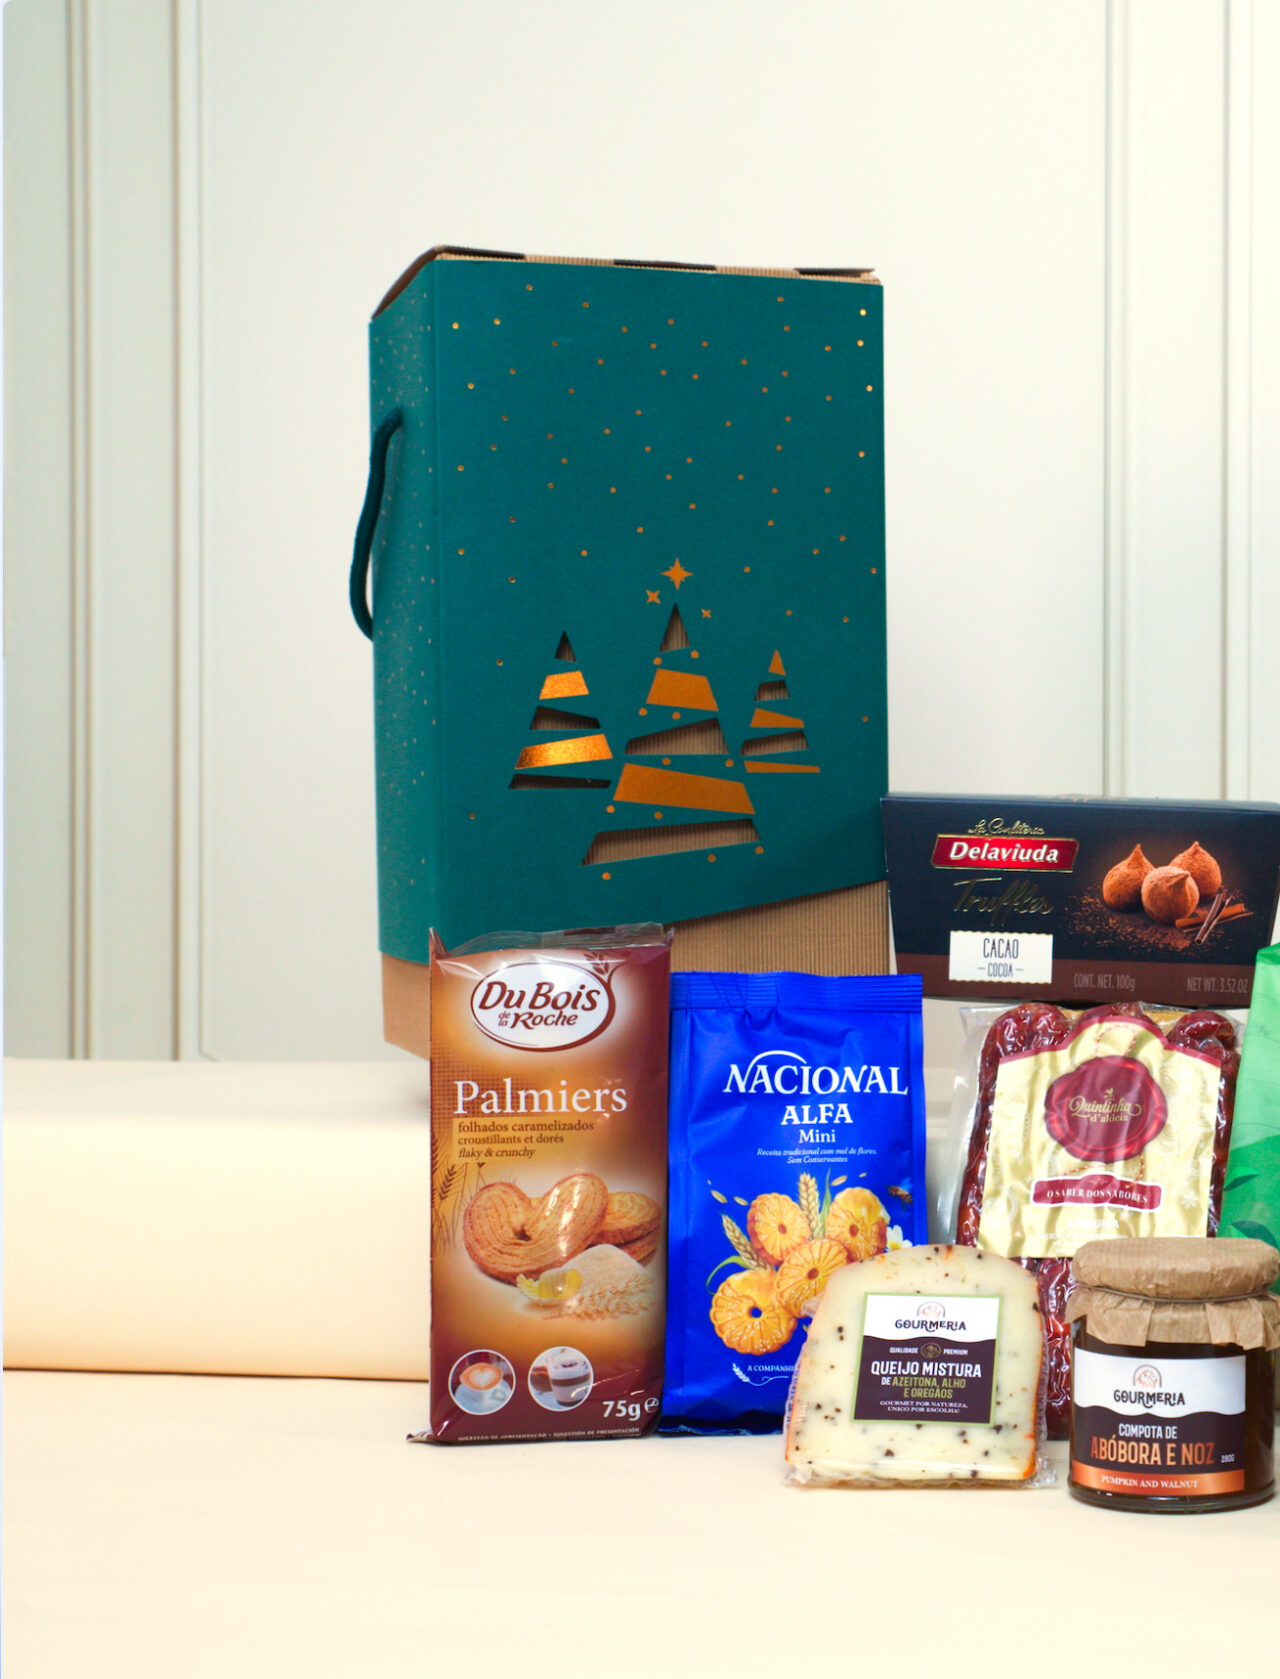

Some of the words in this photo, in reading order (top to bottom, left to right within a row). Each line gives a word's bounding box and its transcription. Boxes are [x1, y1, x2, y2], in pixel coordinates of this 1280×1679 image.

[949, 842, 1059, 862] Delaviuda
[953, 877, 1054, 926] Truffles
[983, 938, 1019, 959] CACAO
[987, 962, 1013, 977] COCOA
[1073, 973, 1096, 987] CONT.
[1098, 974, 1114, 989] NET.
[1116, 974, 1136, 992] 100g
[1187, 977, 1202, 992] NET
[1220, 978, 1236, 993] 3.52
[478, 981, 526, 1010] Du
[528, 981, 600, 1011] Bois
[498, 1011, 510, 1019] de
[510, 1011, 578, 1029] Roche
[723, 1051, 909, 1095] NACIONAL
[453, 1077, 628, 1114] Palmiers
[780, 1103, 853, 1125] ALFA
[458, 1120, 509, 1133] folhados
[511, 1119, 594, 1132] caramelizados
[458, 1134, 522, 1145] croustillants
[524, 1135, 534, 1144] et
[536, 1134, 564, 1144] dorés
[798, 1129, 836, 1143] Mini
[458, 1147, 483, 1160] flaky
[484, 1148, 493, 1157] &
[495, 1147, 536, 1159] crunchy
[757, 1148, 782, 1156] Receita
[783, 1147, 819, 1156] tradicional
[835, 1147, 848, 1155] mel
[787, 1156, 802, 1164] Sem
[1047, 1190, 1053, 1198] O
[1055, 1188, 1084, 1197] SABER
[1086, 1189, 1105, 1198] DOS
[1106, 1189, 1148, 1203] SABORES
[895, 1319, 967, 1333] GOURMERIA
[871, 1361, 919, 1375] QUEIJO
[922, 1361, 981, 1378] MISTURA
[881, 1377, 891, 1385] DE
[892, 1377, 940, 1388] AZEITONA,
[942, 1378, 966, 1389] ALHO
[904, 1388, 909, 1398] E
[1113, 1389, 1186, 1408] GOURMERIA
[602, 1400, 641, 1421] 75g
[1118, 1423, 1163, 1439] COMPOTA
[1165, 1426, 1178, 1439] DE
[1090, 1434, 1162, 1465] ABÓBORA
[1166, 1443, 1176, 1465] E
[1181, 1441, 1216, 1466] NOZ
[1101, 1474, 1138, 1487] PUMPKIN
[1140, 1478, 1159, 1488] AND
[1161, 1478, 1199, 1489] WALNUT
